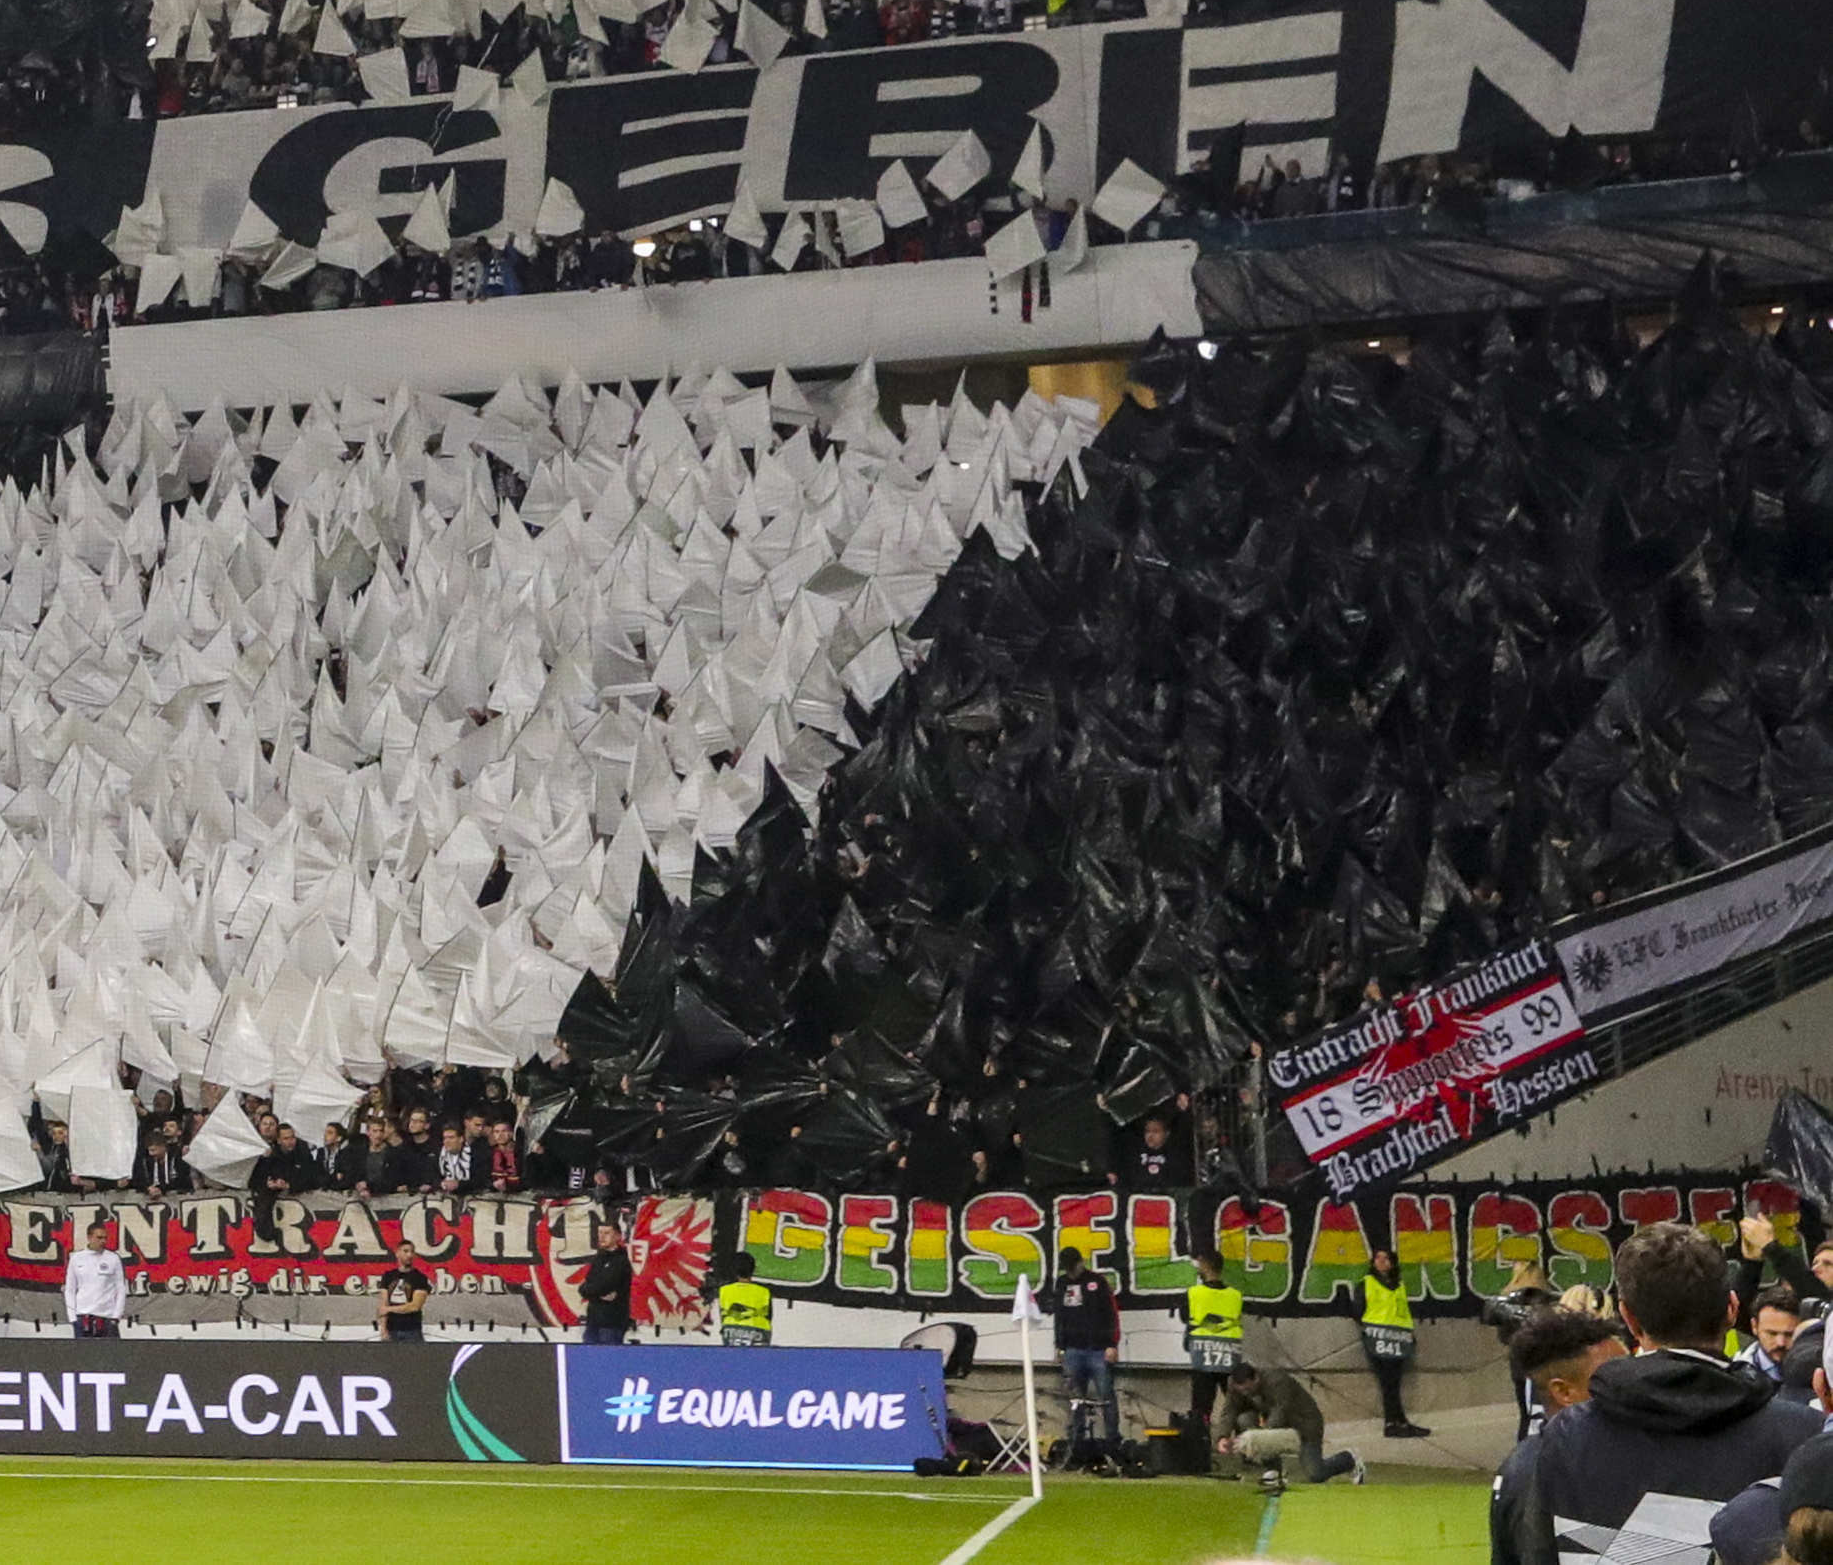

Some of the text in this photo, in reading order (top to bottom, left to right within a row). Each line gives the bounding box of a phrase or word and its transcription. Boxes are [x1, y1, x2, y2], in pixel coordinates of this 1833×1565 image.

[1268, 938, 1548, 1088] Eintracht Frankfurt
[1301, 995, 1563, 1138] 18 Supporters 99
[1319, 1050, 1599, 1205] Brachttal Hessen
[167, 1266, 251, 1297] ewig
[269, 1267, 329, 1296] dir
[1376, 1340, 1402, 1356] 841
